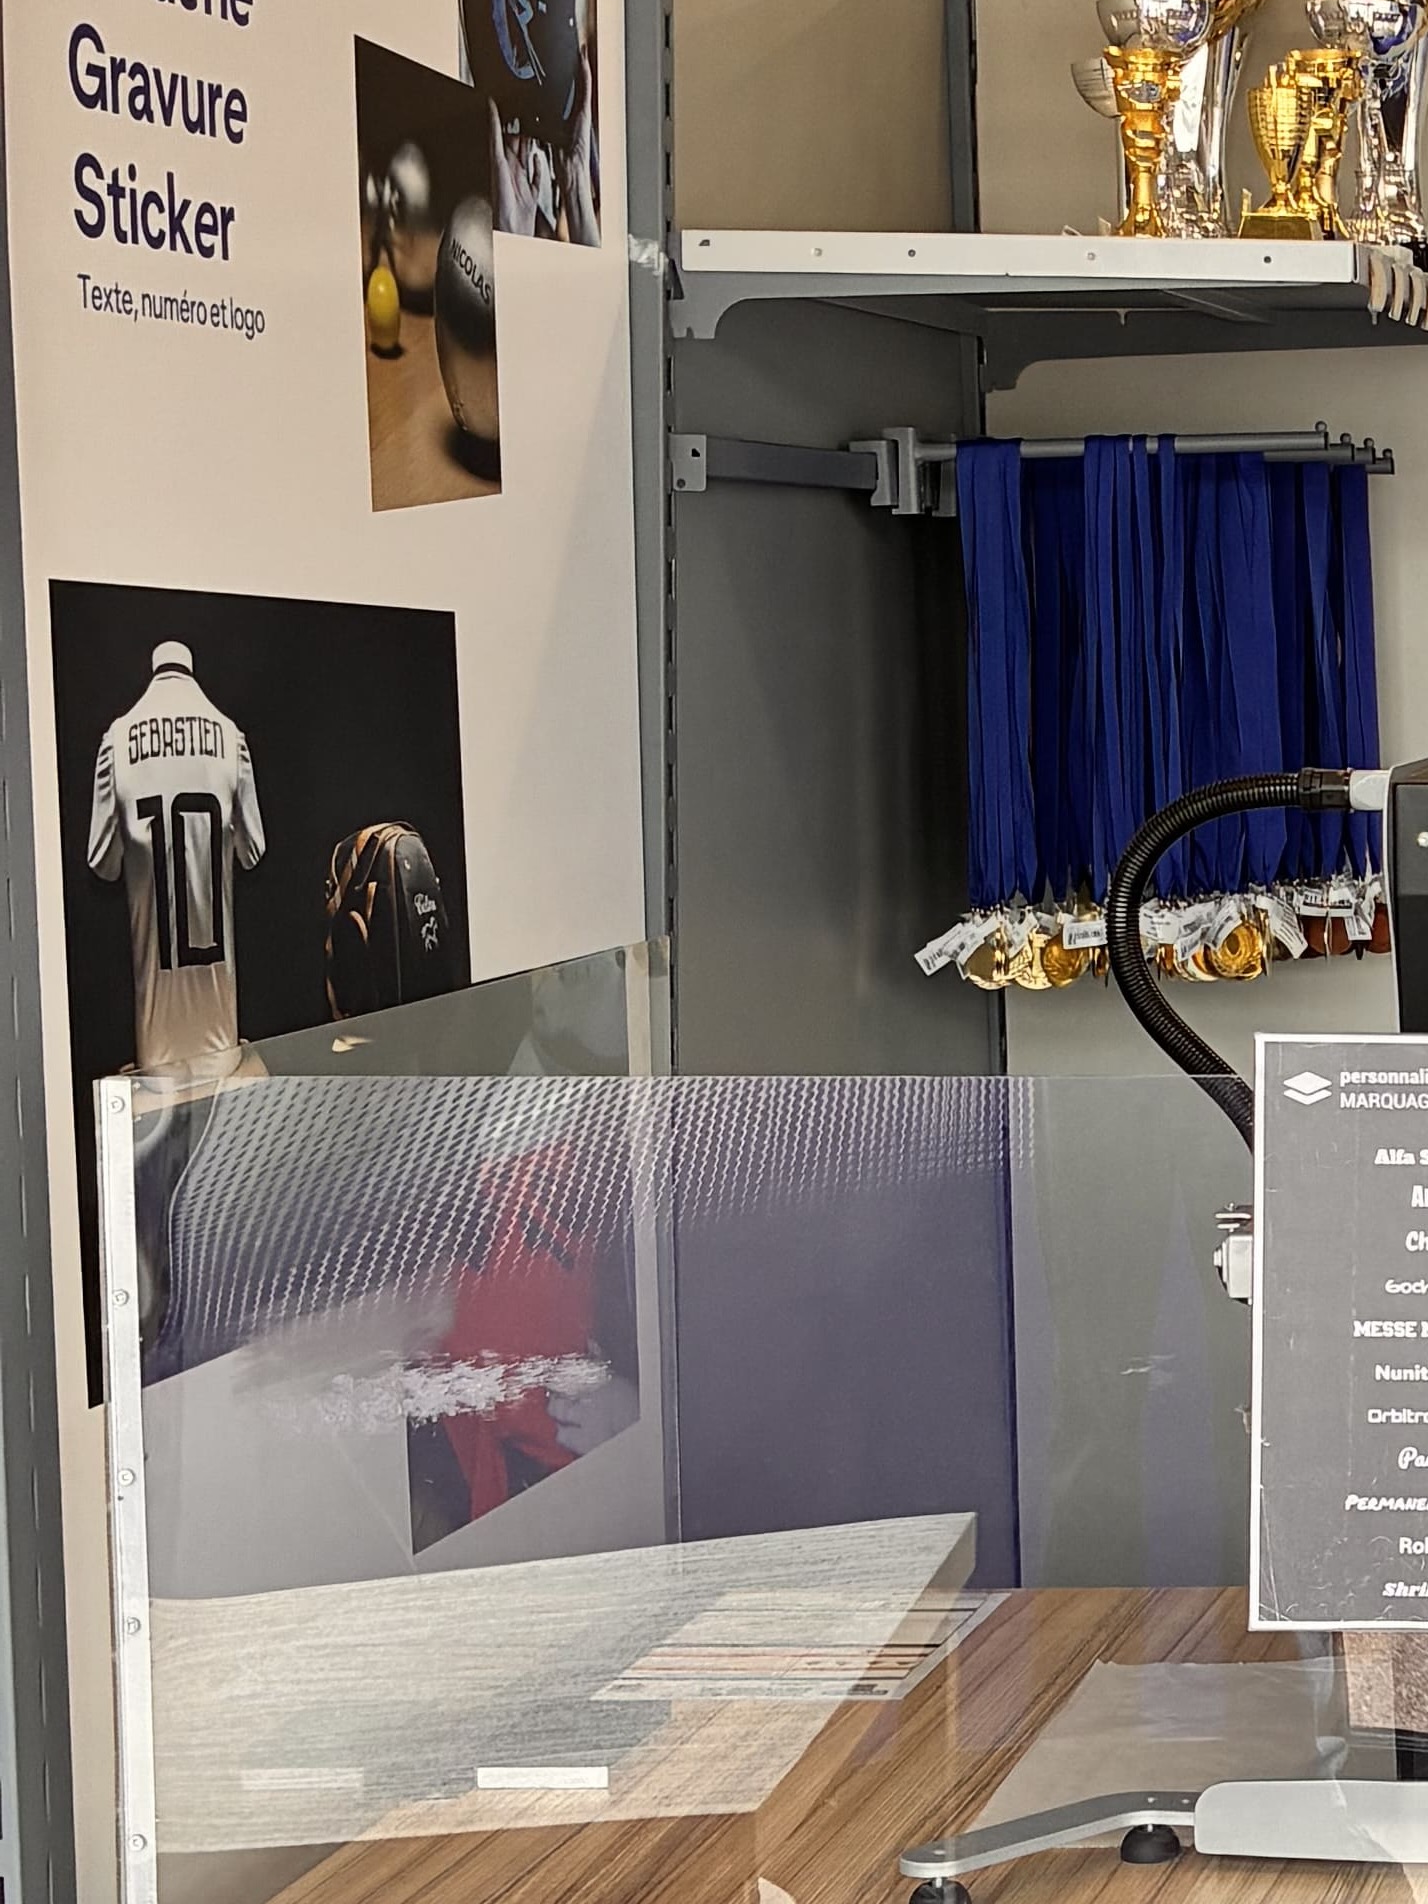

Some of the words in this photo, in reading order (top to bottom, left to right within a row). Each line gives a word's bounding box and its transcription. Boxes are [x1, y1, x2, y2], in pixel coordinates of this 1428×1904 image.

[68, 22, 249, 146] Gravure
[73, 152, 237, 262] Sticker
[451, 237, 493, 306] NICOLAS
[77, 273, 140, 322] Texte,
[141, 290, 208, 327] numéro
[210, 298, 229, 327] et
[230, 298, 266, 338] logo
[127, 716, 227, 765] SEBASTIEN
[136, 792, 226, 970] 10
[1374, 1148, 1416, 1165] Alfa
[1353, 1320, 1418, 1337] MESSE
